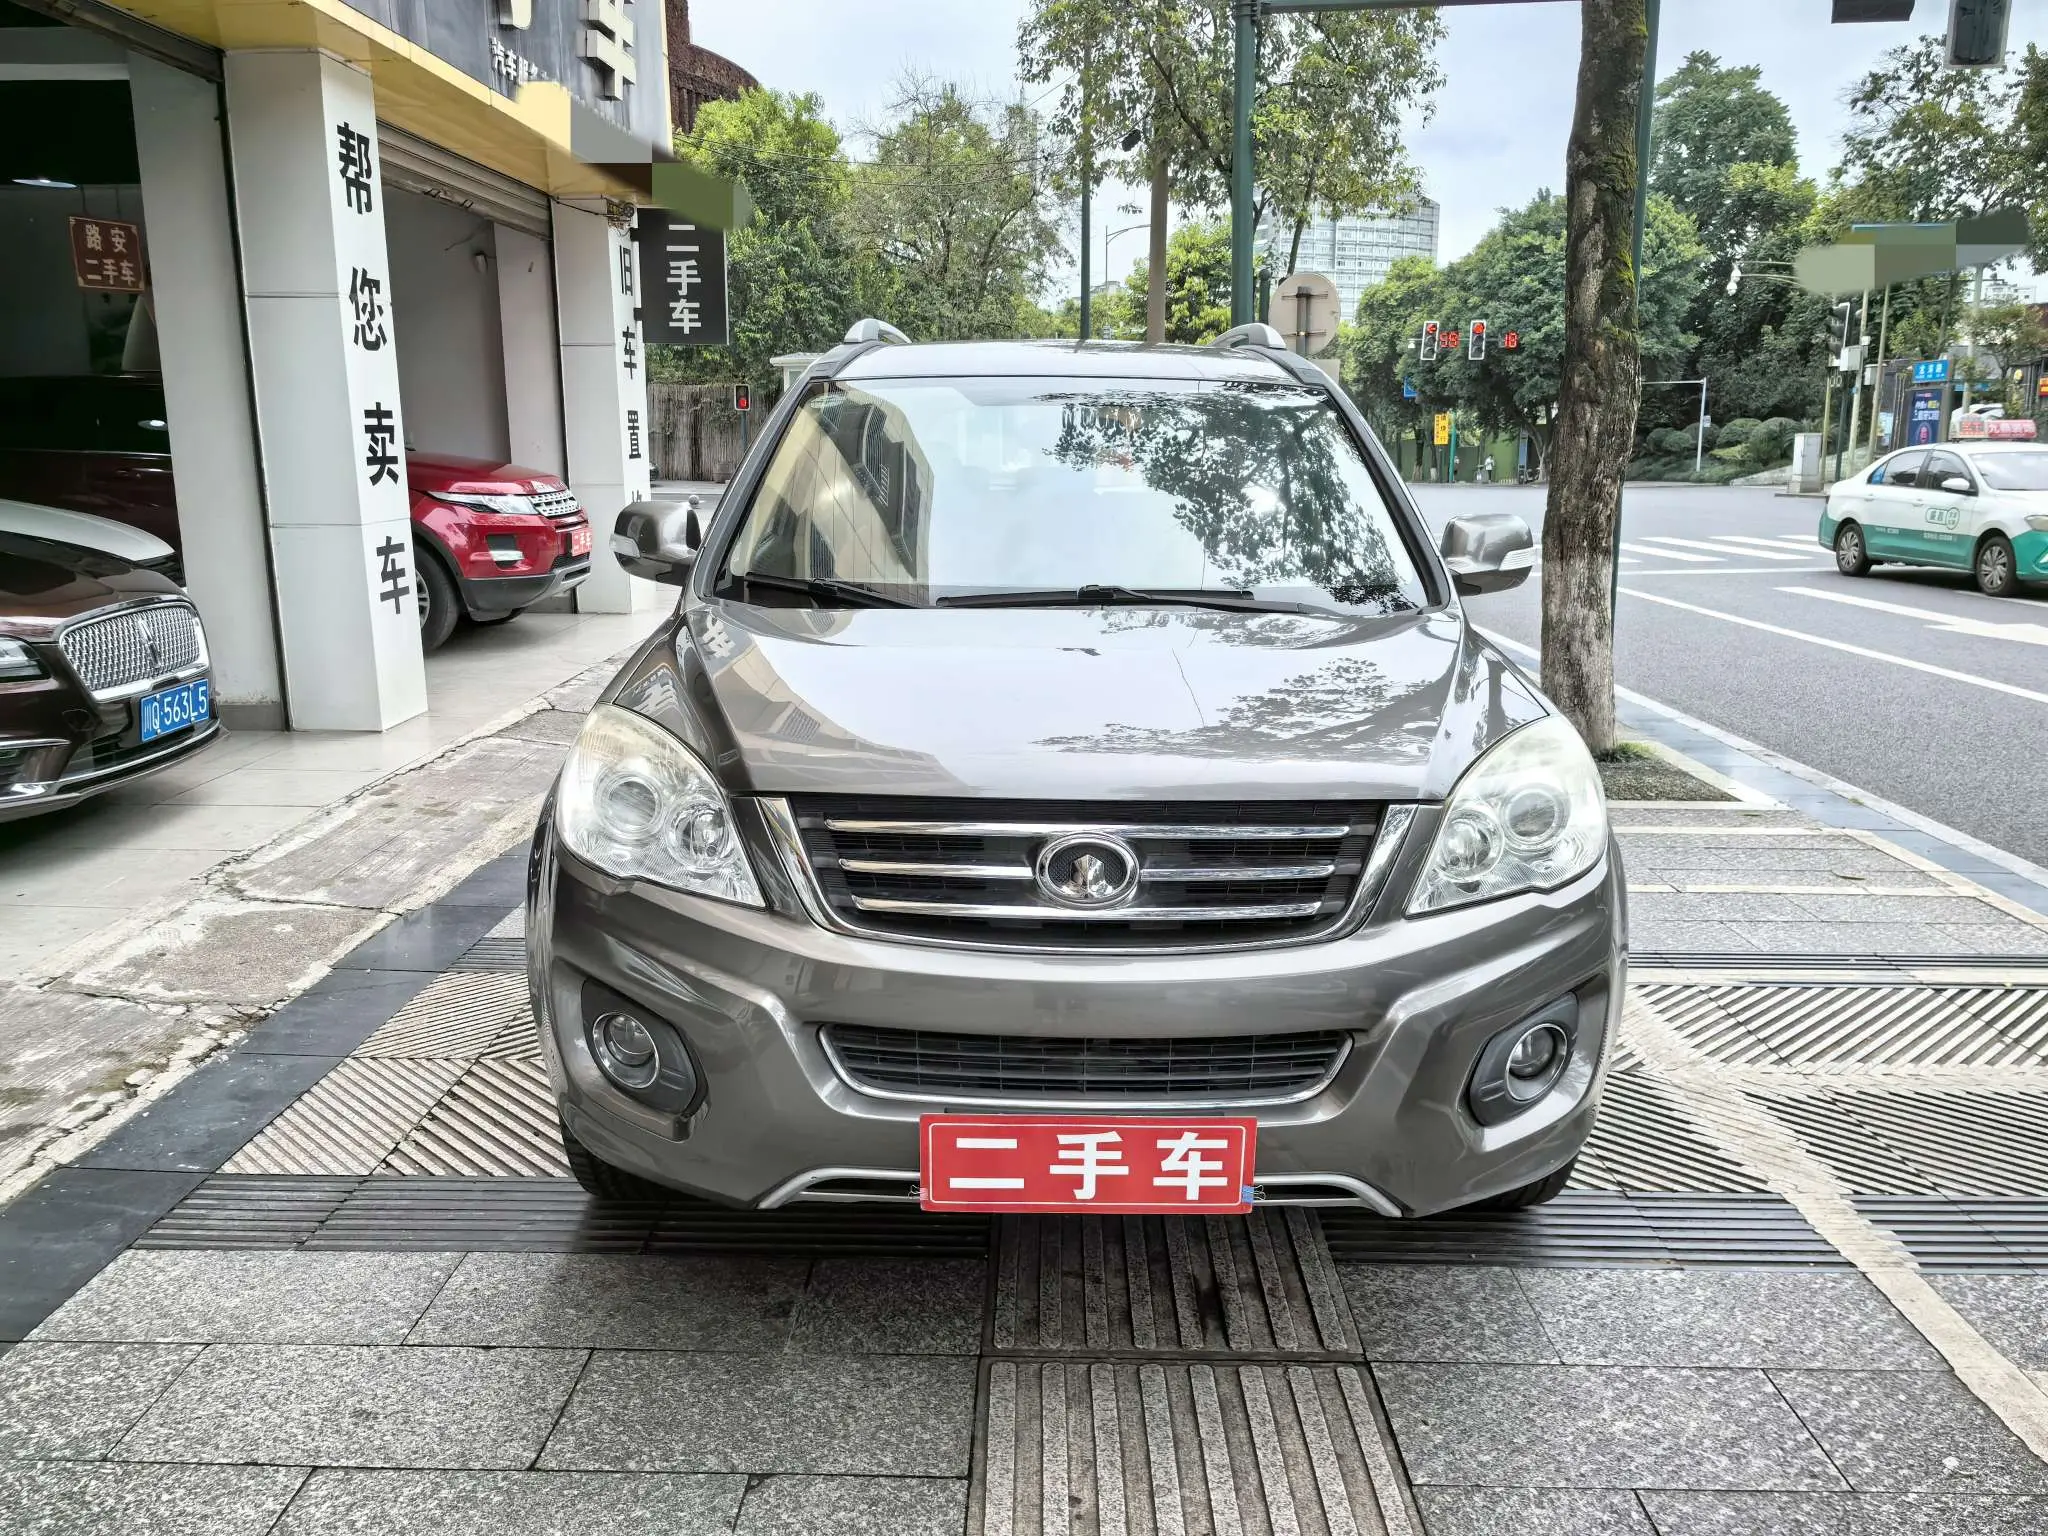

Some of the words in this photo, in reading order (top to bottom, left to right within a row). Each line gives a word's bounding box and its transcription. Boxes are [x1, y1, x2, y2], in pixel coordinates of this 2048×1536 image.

[85, 223, 128, 253] 路安
[85, 258, 137, 287] 二手车
[666, 224, 702, 335] 二手车
[336, 121, 411, 616] 帮您卖车
[619, 244, 643, 503] 旧车置
[948, 1130, 1229, 1201] 二手车
